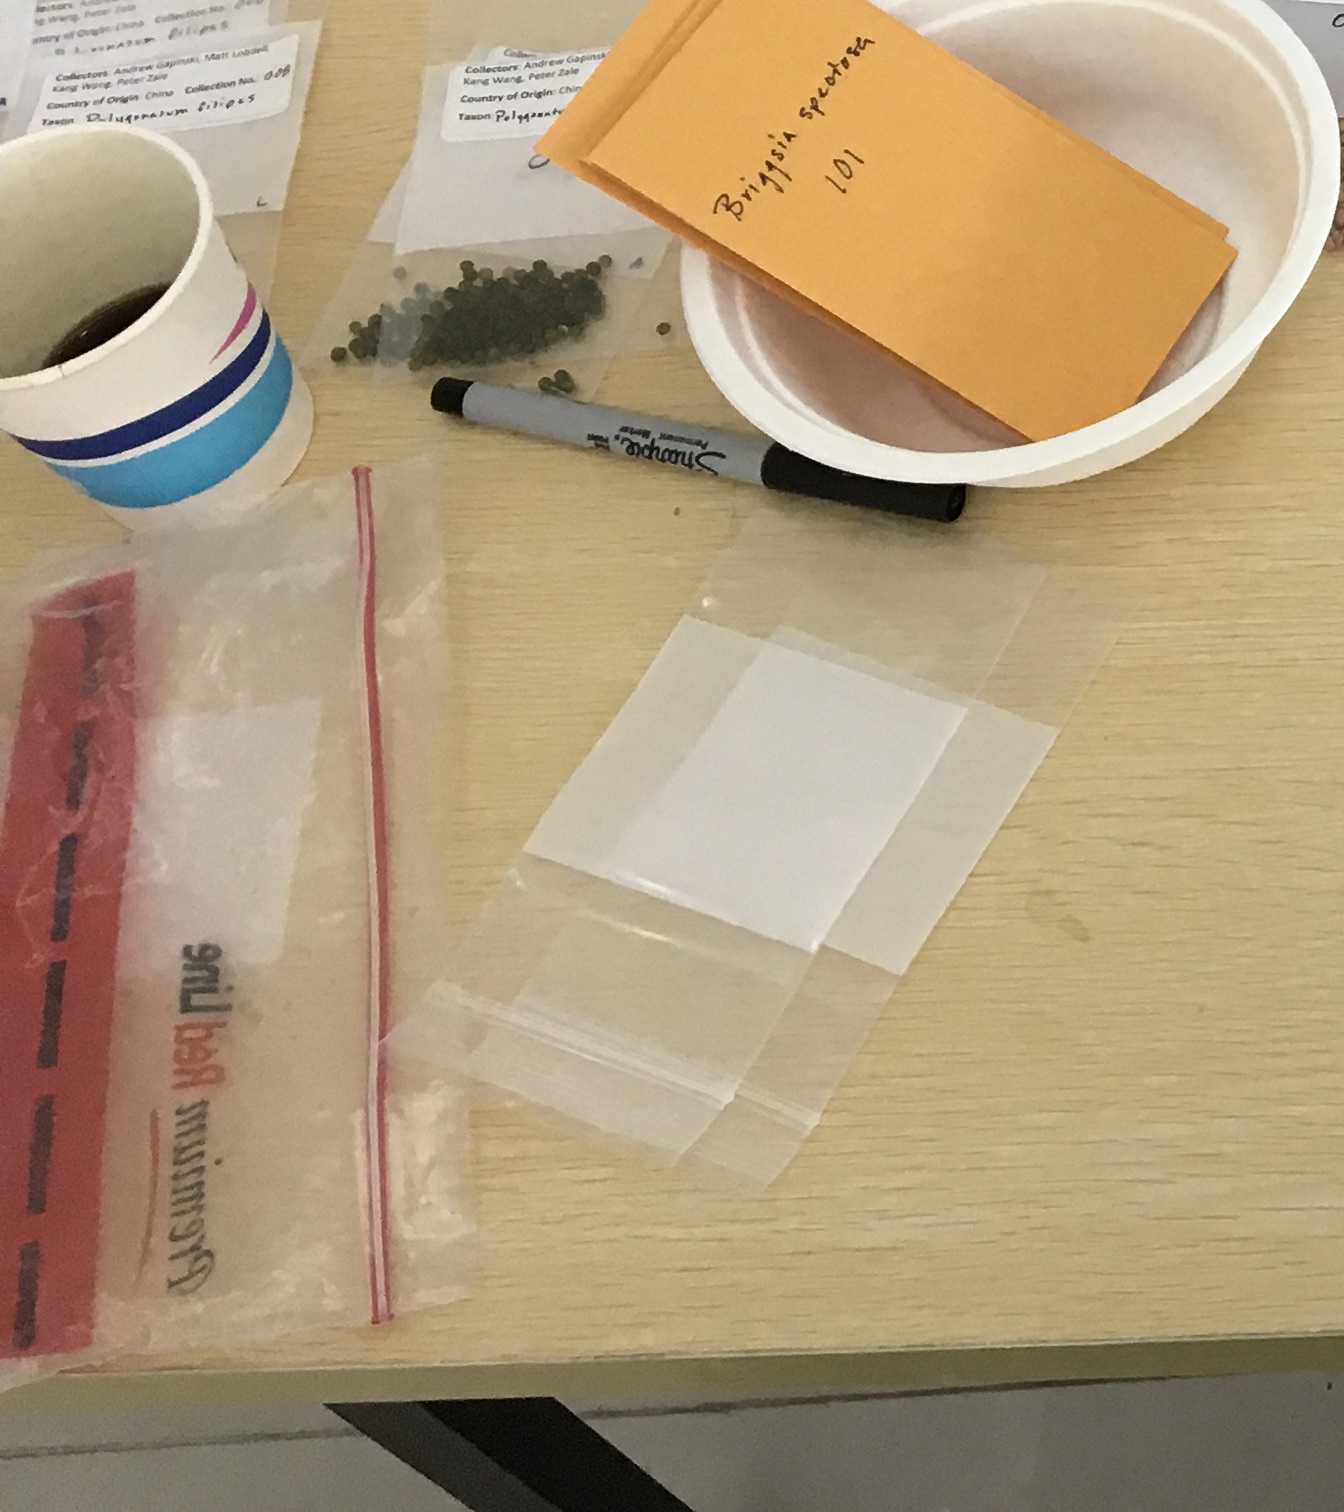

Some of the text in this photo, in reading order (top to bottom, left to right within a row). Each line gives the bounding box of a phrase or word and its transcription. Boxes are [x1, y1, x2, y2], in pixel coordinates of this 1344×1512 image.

[460, 95, 503, 103] Country
[507, 92, 518, 101] of
[713, 132, 798, 221] Briggsia
[824, 149, 865, 194] 101
